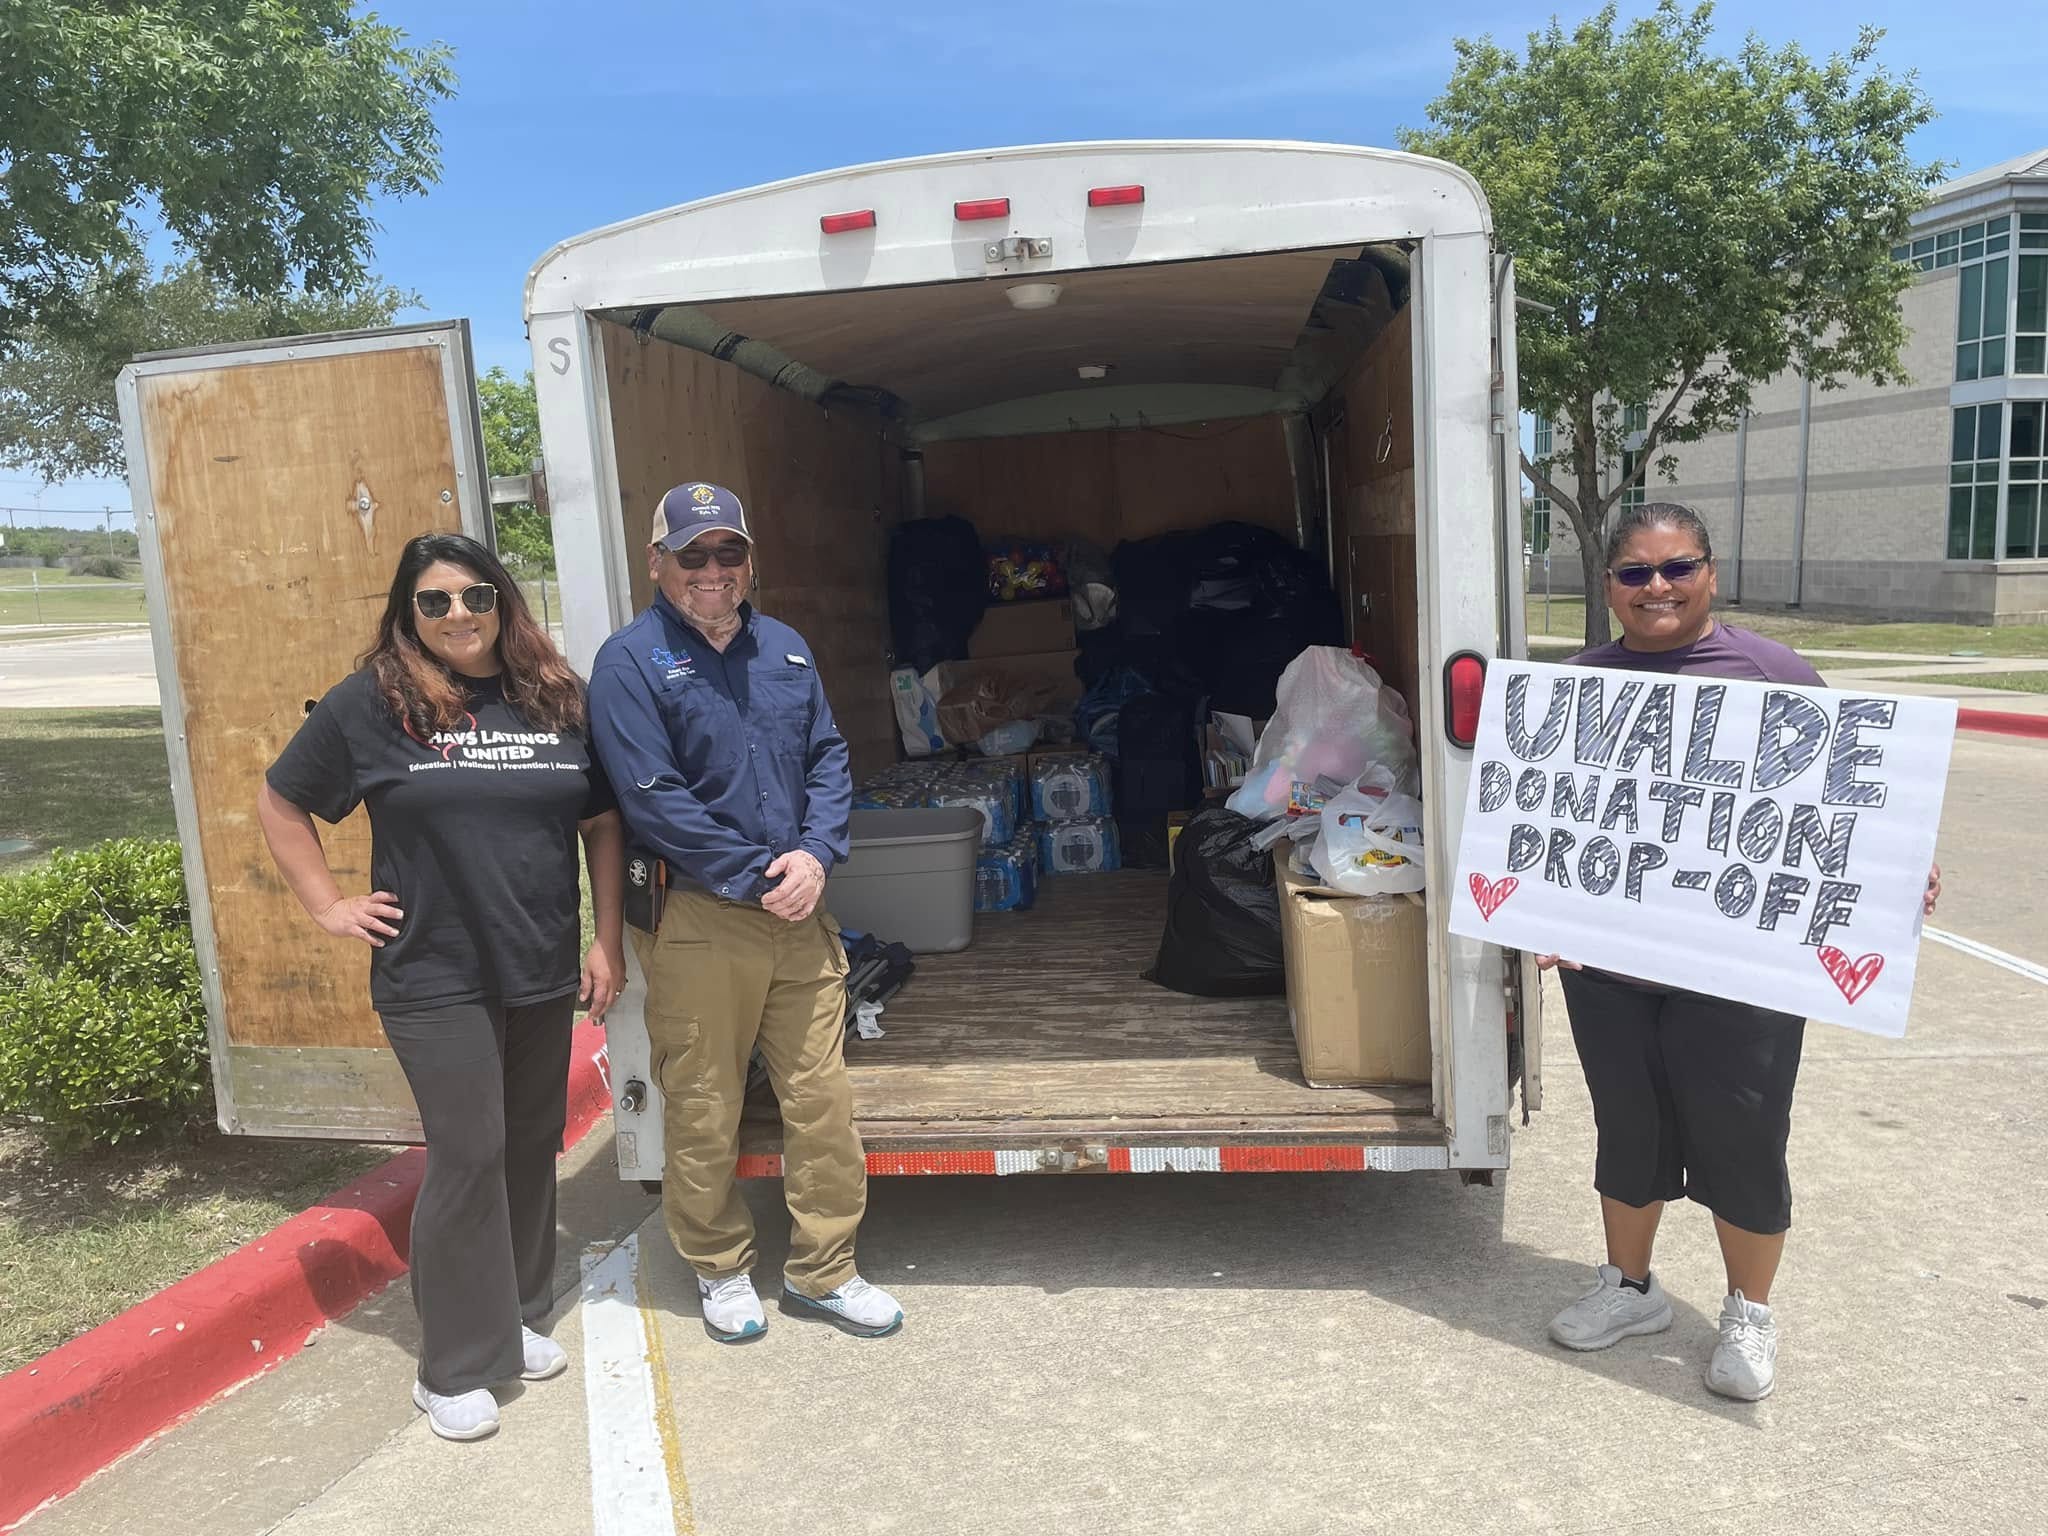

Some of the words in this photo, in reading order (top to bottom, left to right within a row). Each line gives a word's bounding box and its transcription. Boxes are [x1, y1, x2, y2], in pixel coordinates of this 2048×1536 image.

[548, 336, 571, 376] S
[462, 745, 535, 761] UNITED
[480, 730, 560, 746] LATINOS
[1505, 673, 1898, 809] UVALDE
[408, 760, 452, 773] Education
[458, 760, 496, 770] Wellness
[502, 761, 550, 770] Prevention
[555, 762, 580, 770] Access
[1479, 760, 1858, 879] DONATION
[1507, 823, 1862, 947] DROP-OFF
